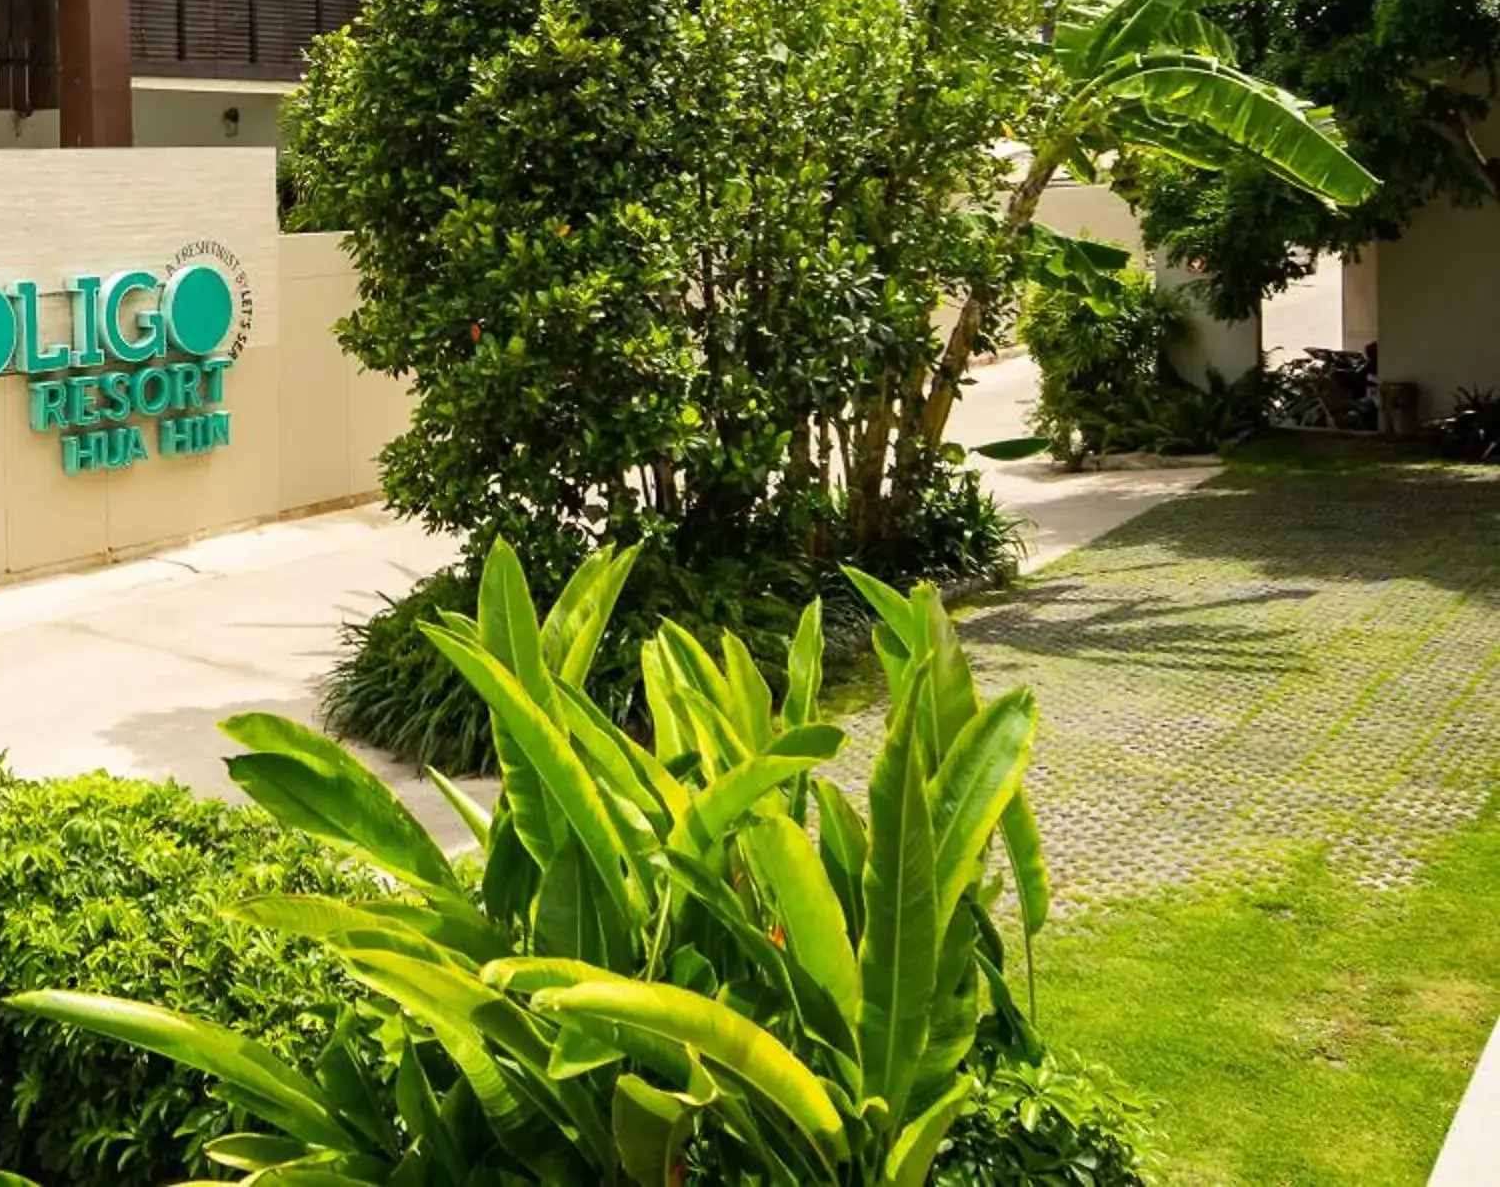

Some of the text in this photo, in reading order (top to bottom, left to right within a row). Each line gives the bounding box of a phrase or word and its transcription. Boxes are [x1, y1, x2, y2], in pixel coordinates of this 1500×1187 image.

[165, 263, 177, 277] A
[241, 290, 253, 329] LET'S
[228, 333, 247, 360] SEA
[31, 359, 233, 432] RESORT
[63, 410, 231, 475] HUA HIN
